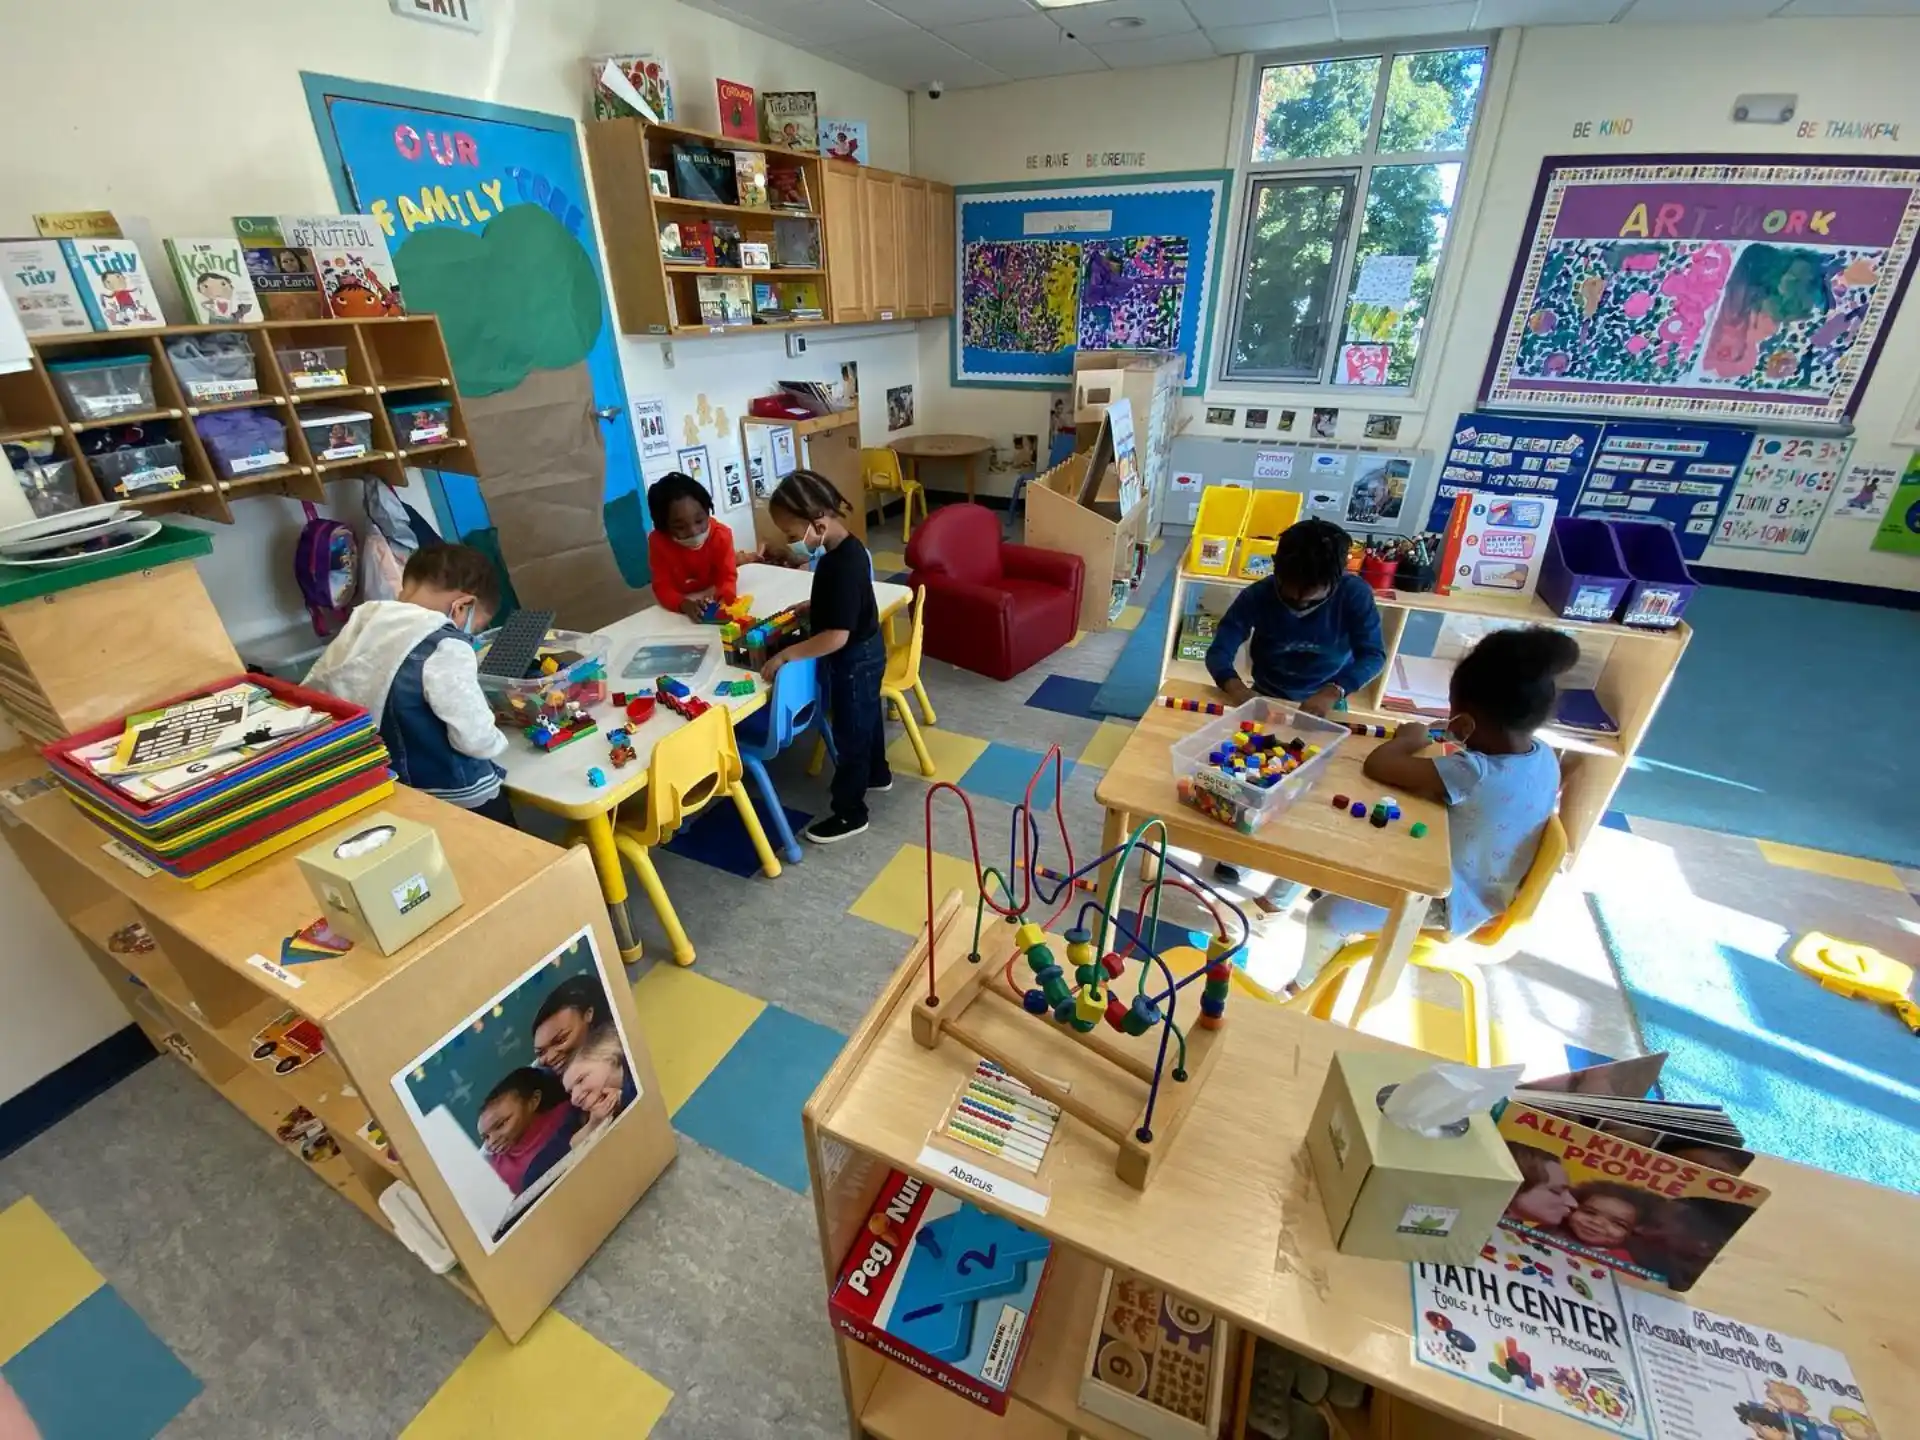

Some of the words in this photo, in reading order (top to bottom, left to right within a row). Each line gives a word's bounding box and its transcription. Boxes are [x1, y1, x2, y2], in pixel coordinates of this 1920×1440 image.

[1572, 121, 1593, 139] BE
[1599, 118, 1634, 136] KIND
[1797, 120, 1819, 138] BE
[1825, 120, 1900, 141] THANKFUL
[395, 124, 479, 167] OUR
[1026, 155, 1038, 169] BE
[1086, 153, 1098, 168] BE
[1101, 152, 1146, 167] CREATIVE
[371, 178, 505, 236] FAMILY
[53, 219, 83, 231] NOT
[1619, 202, 1717, 238] ART
[1731, 202, 1837, 238] WORK
[293, 225, 374, 247] BEAUTIFUL
[81, 251, 138, 276] Tidy
[181, 248, 241, 278] Kind
[15, 270, 57, 287] Tidy
[257, 276, 282, 288] Our
[283, 275, 316, 288] Earth
[1756, 438, 1765, 455] 1
[1783, 440, 1799, 457] 2
[1818, 442, 1830, 458] 3
[1257, 453, 1292, 464] Primary
[1258, 467, 1289, 476] Colors
[1744, 467, 1756, 482] 4
[1774, 469, 1789, 485] 5
[1806, 472, 1820, 487] 6
[1735, 494, 1745, 509] 7
[1776, 498, 1789, 513] 8
[1722, 521, 1733, 536] 9
[1760, 525, 1779, 540] 10
[1514, 1111, 1575, 1143] ALL
[1585, 1134, 1702, 1183] KINDS
[1706, 1177, 1760, 1200] OF
[949, 1165, 995, 1194] Abacus.
[1563, 1145, 1688, 1197] PEOPLE
[957, 1243, 997, 1276] 2
[848, 1241, 893, 1297] Peg
[1471, 1303, 1479, 1316] &
[1506, 1281, 1621, 1348] CENTER
[1693, 1310, 1759, 1347] Math
[1766, 1334, 1783, 1354] &
[840, 1319, 865, 1340] Peg
[877, 1340, 934, 1375] Number
[937, 1373, 990, 1404] Boards
[1632, 1313, 1788, 1379] Manipulative
[1797, 1365, 1864, 1401] Area
